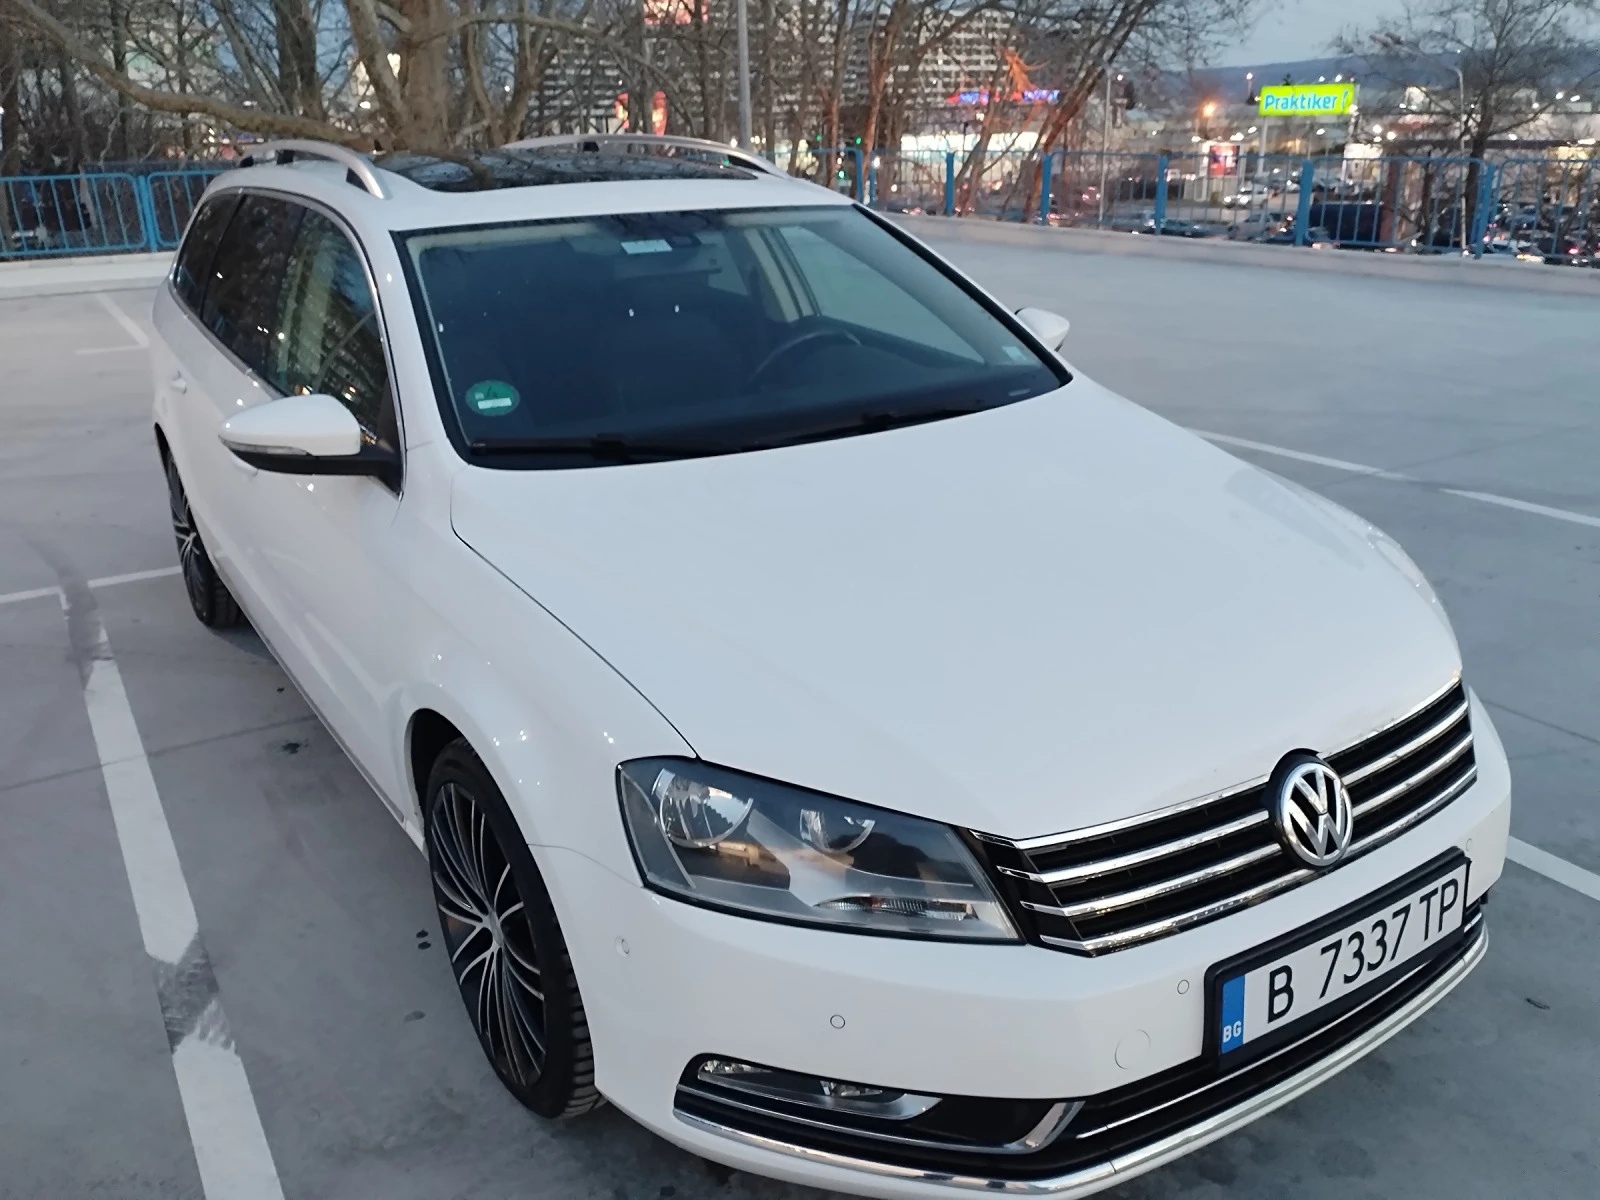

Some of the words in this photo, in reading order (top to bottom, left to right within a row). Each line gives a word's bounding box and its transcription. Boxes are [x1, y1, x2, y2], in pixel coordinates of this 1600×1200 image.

[1264, 92, 1338, 110] Praktiker
[1267, 964, 1295, 1024] B
[1318, 904, 1411, 999] 7337
[1419, 878, 1459, 942] TP
[1222, 1020, 1242, 1043] BG
